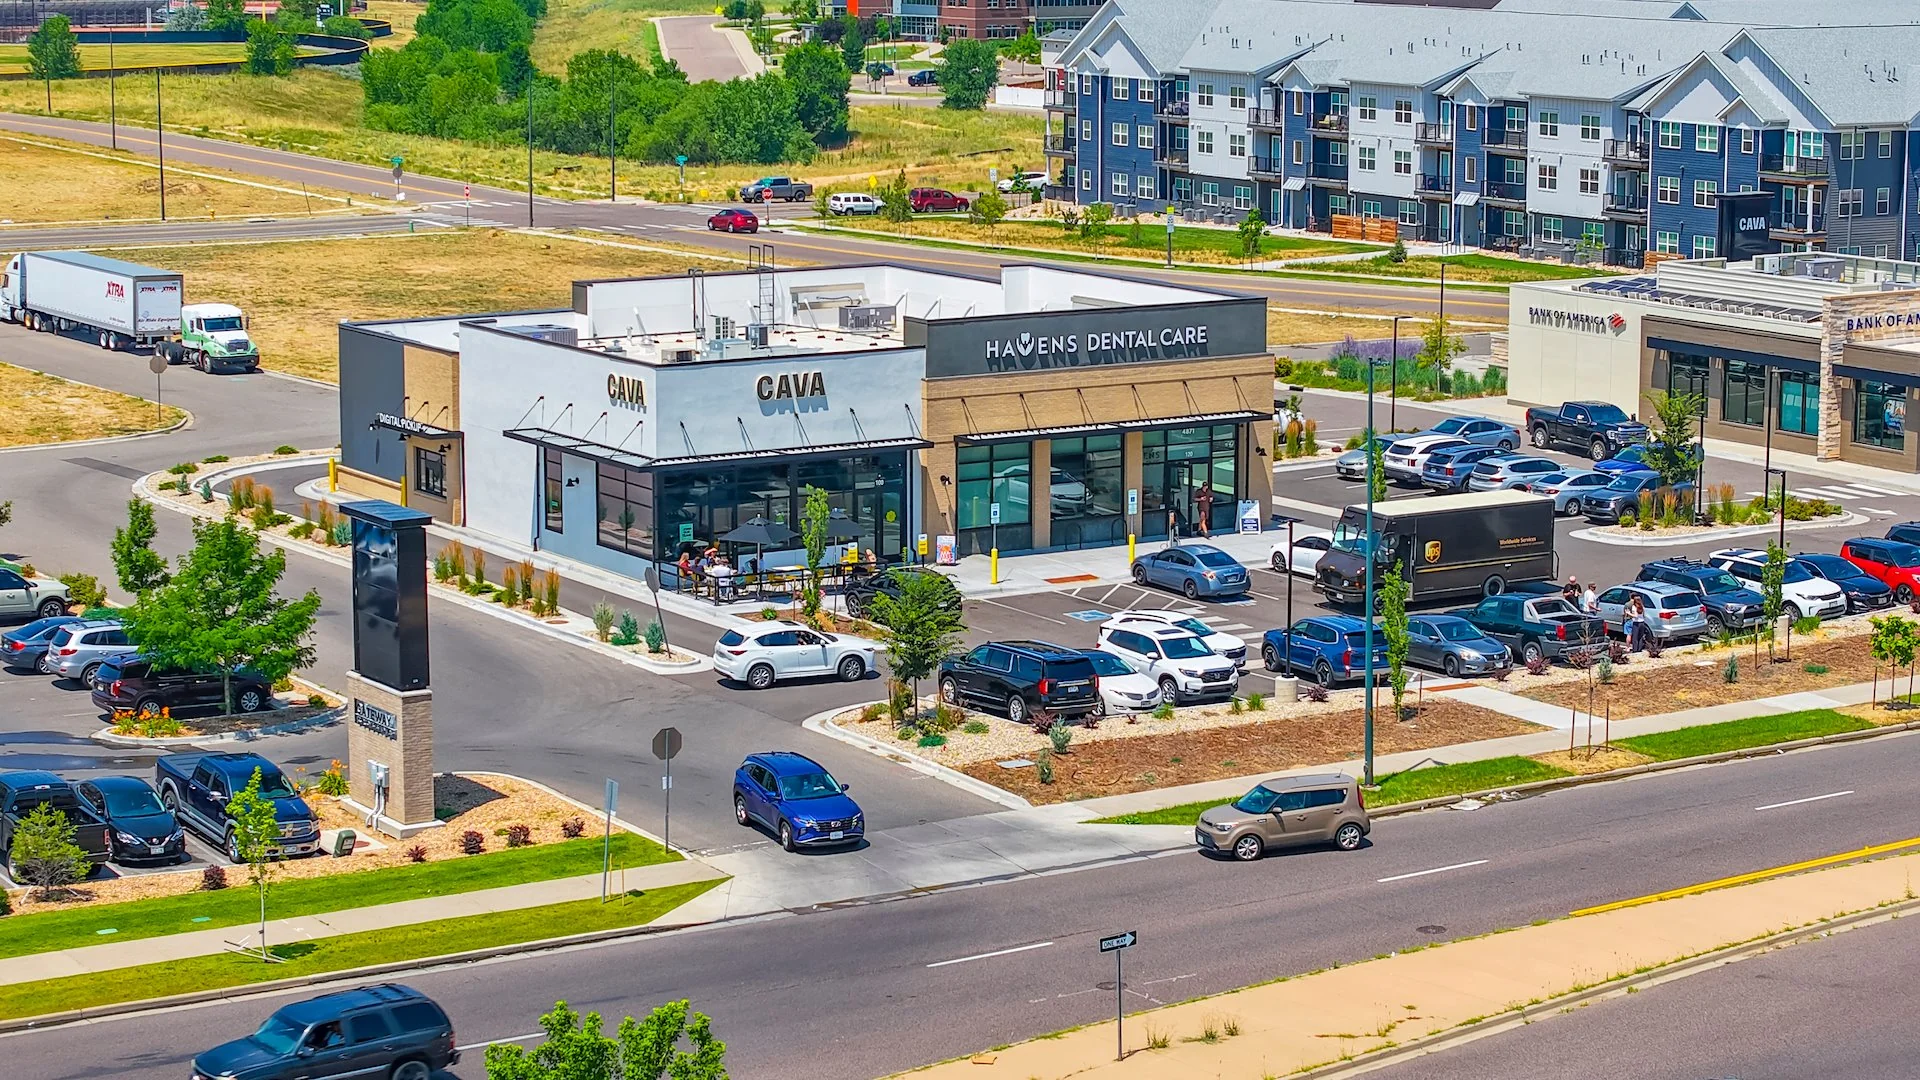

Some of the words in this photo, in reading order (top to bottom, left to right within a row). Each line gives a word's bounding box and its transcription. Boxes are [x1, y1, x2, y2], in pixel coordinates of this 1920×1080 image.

[1740, 217, 1766, 231] CAVA
[105, 281, 124, 298] XTRA
[1529, 307, 1552, 317] BANK
[1553, 310, 1565, 320] OF
[1566, 312, 1605, 326] AMERICA
[1847, 316, 1882, 331] BANK
[1886, 314, 1903, 327] OF
[985, 332, 1078, 359] HAVENS
[1087, 329, 1157, 352] DENTAL
[1160, 326, 1208, 347] CARE
[607, 373, 645, 406] CAVA
[756, 371, 826, 401] CAVA
[379, 412, 402, 428] DIGITAL
[401, 418, 423, 433] PICKUP
[1426, 546, 1440, 560] ups
